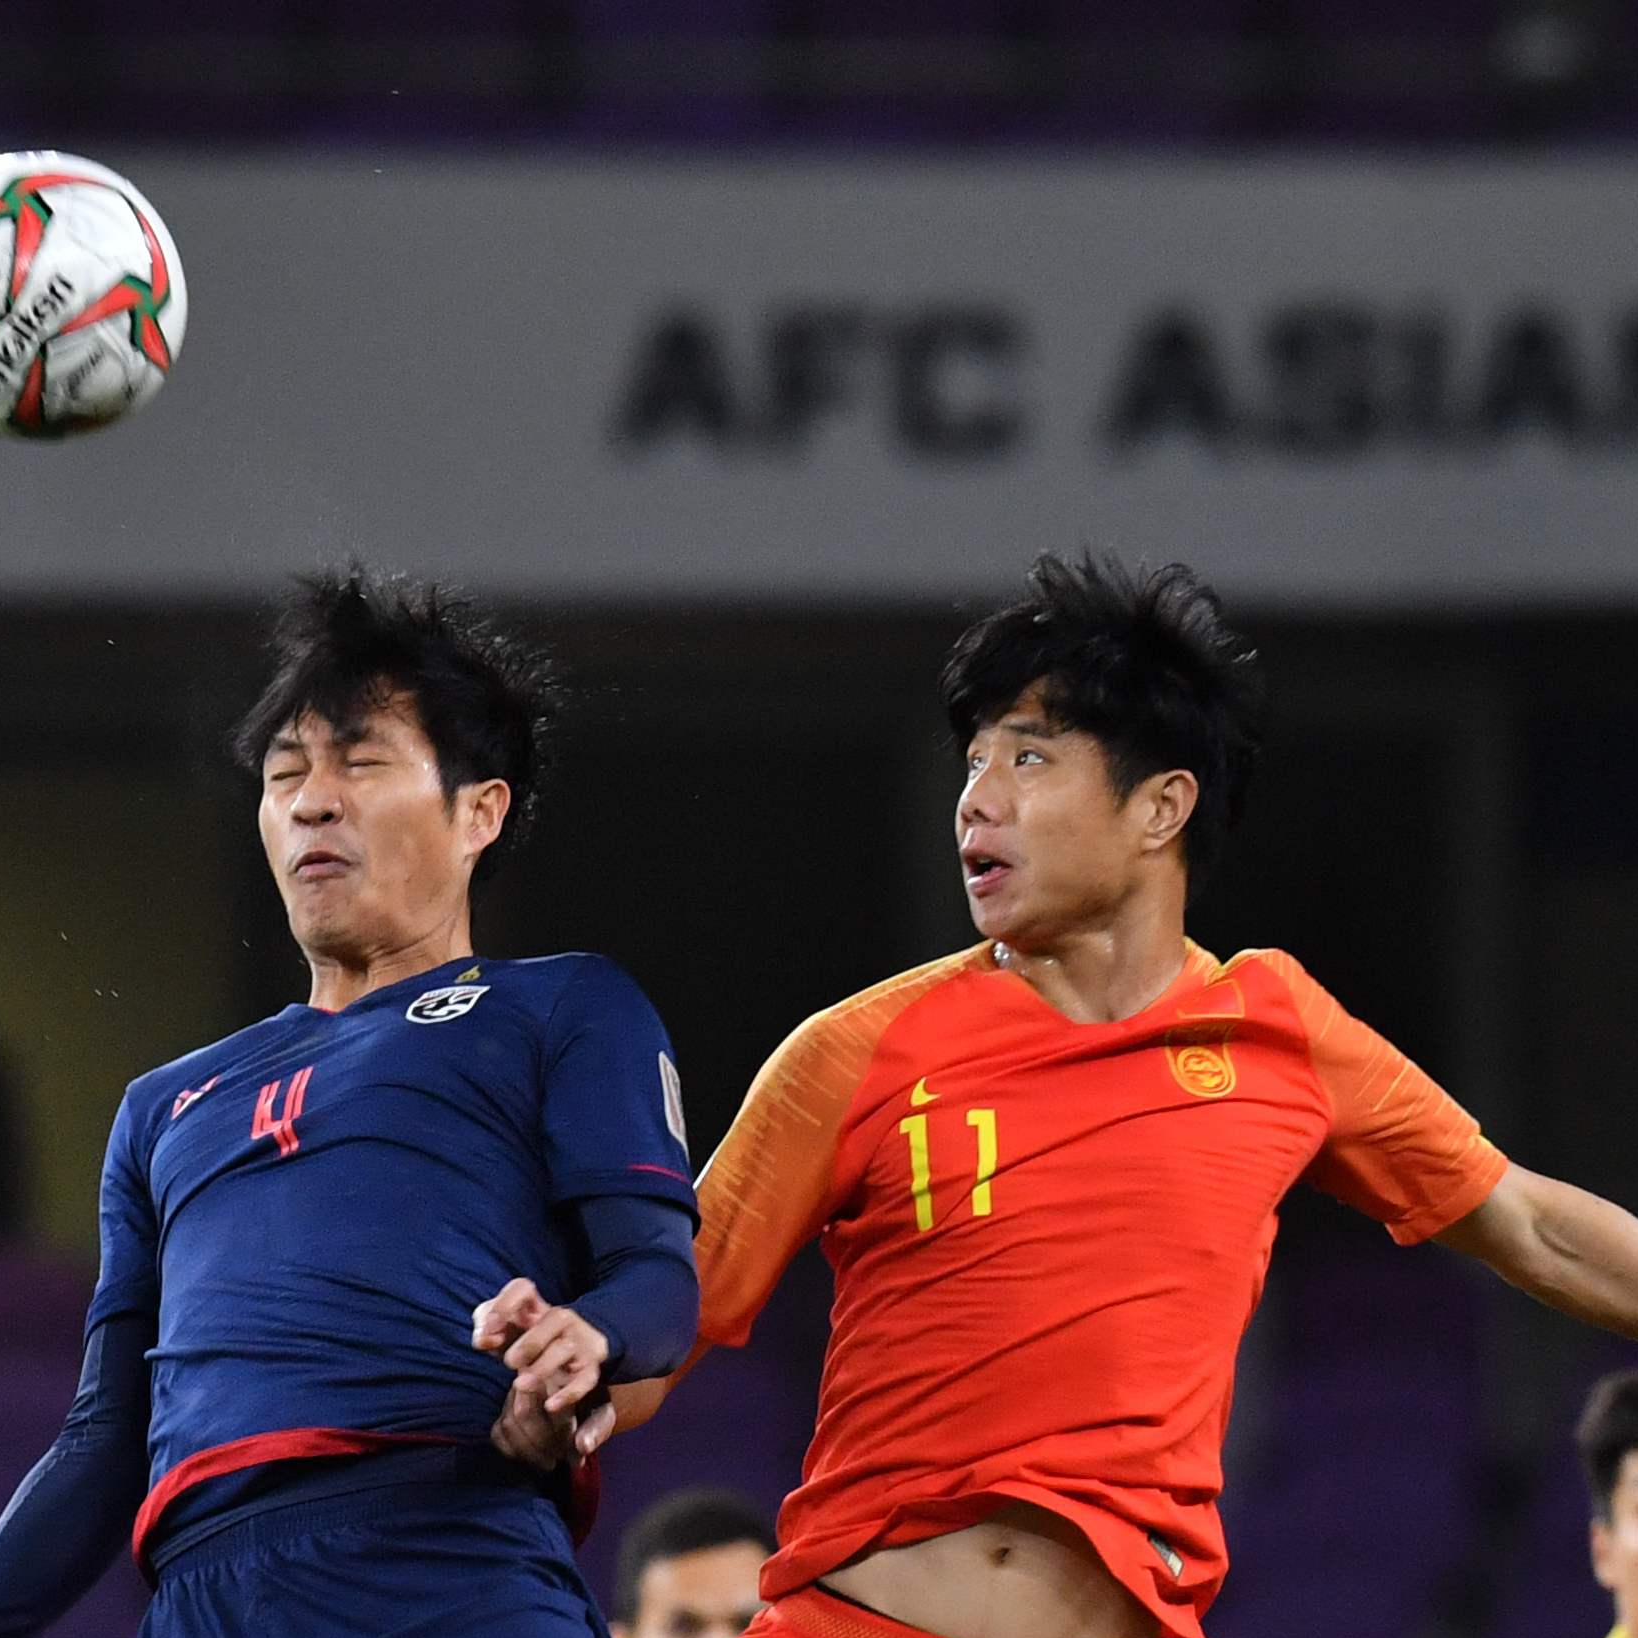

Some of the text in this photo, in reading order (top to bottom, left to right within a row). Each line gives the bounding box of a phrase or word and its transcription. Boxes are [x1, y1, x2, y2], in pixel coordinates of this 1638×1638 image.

[612, 304, 1025, 464] AFC
[250, 1066, 313, 1158] 4
[898, 1108, 998, 1232] 11
